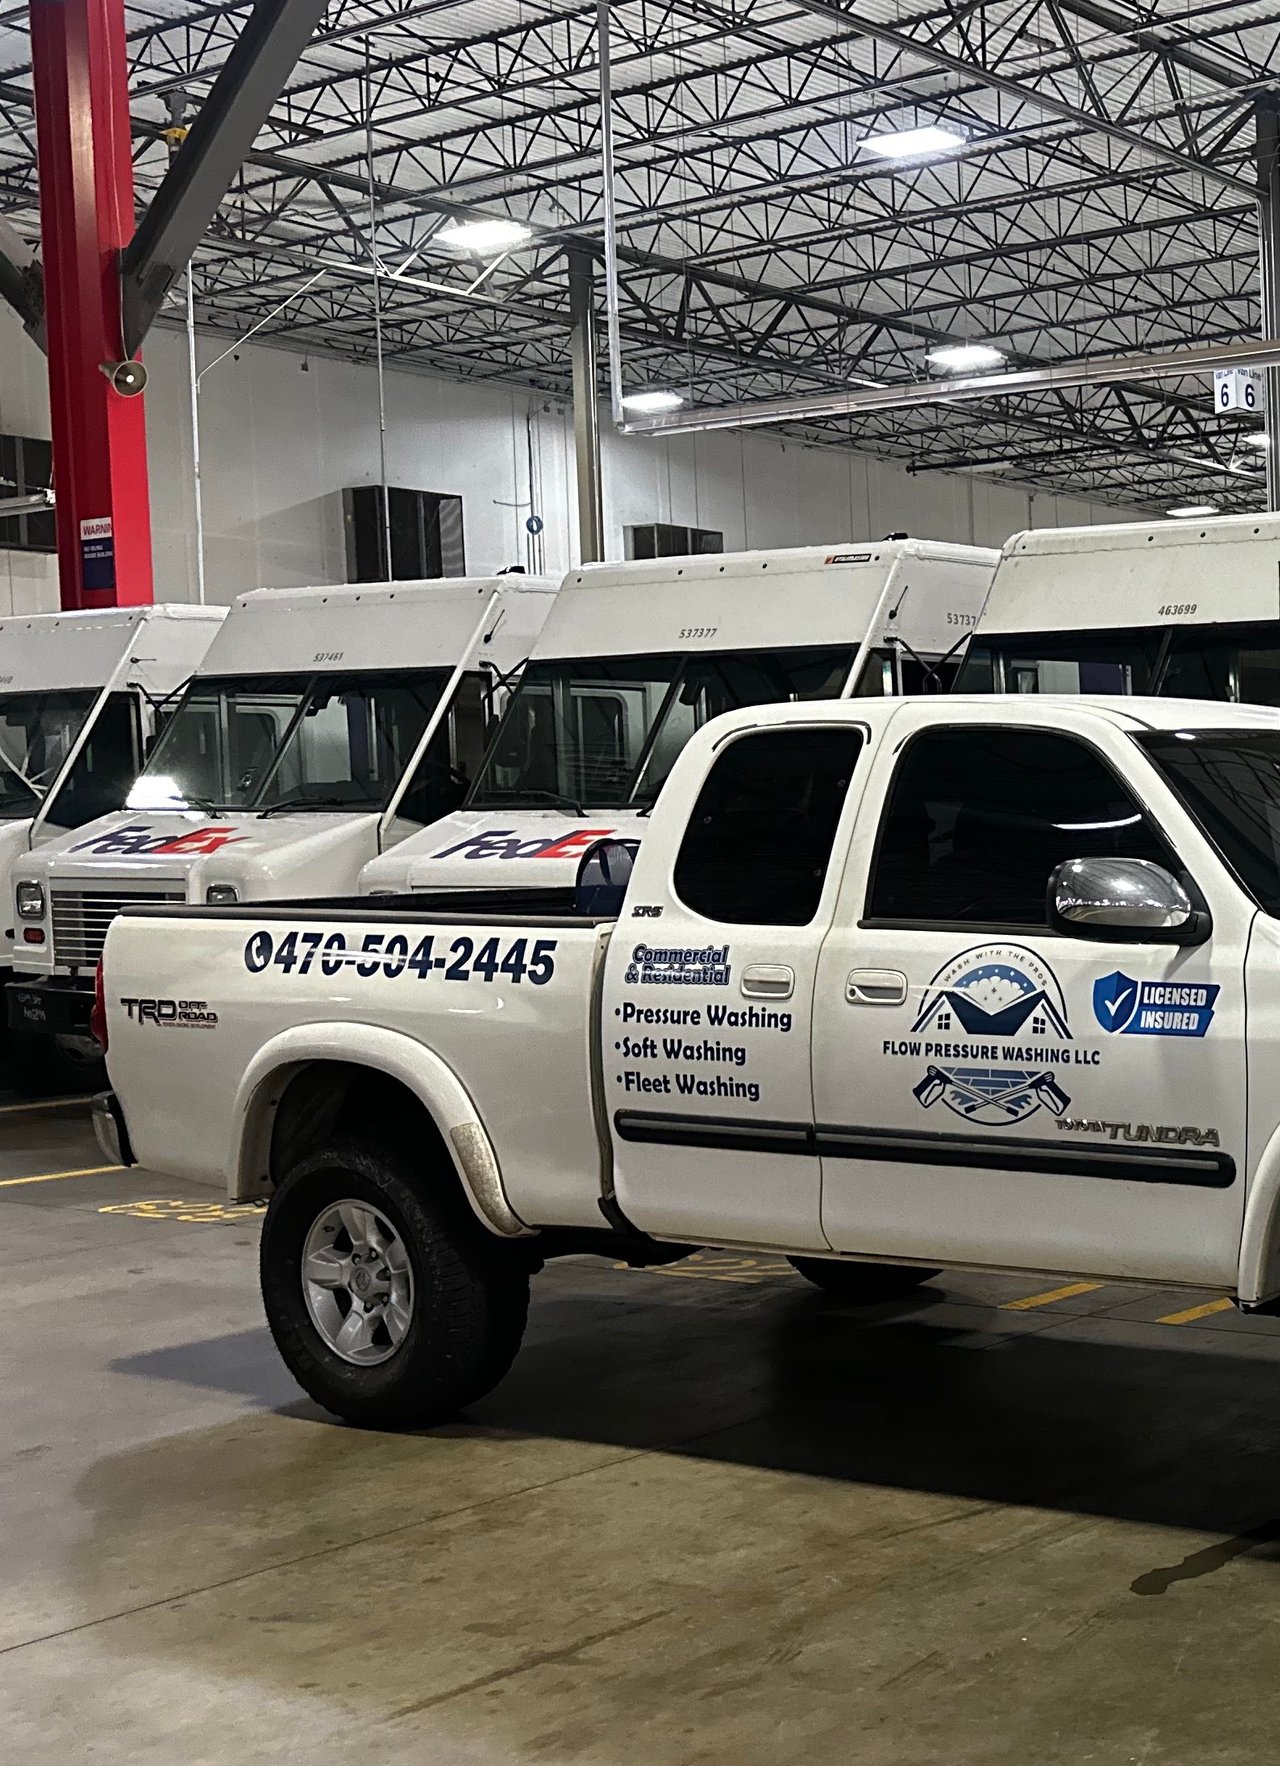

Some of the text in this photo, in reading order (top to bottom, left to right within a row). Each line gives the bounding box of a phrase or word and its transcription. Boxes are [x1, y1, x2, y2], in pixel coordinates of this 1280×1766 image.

[1221, 383, 1229, 407] 6
[1245, 383, 1255, 408] 6
[946, 612, 977, 627] 53737
[1158, 603, 1198, 616] 463699
[678, 627, 718, 639] 537377
[67, 825, 252, 855] FedEx
[429, 829, 618, 860] FedE
[273, 931, 558, 986] 470-504-2445
[632, 943, 730, 965] Commercial
[624, 963, 732, 985] & Residential
[944, 950, 1048, 987] WASH WITH THE PROS
[1143, 986, 1207, 1007] LICENSED
[120, 998, 208, 1027] TRD OFF
[178, 1011, 219, 1024] ROAD
[622, 1002, 792, 1033] Pressure Washing
[1140, 1010, 1200, 1031] INSURED
[622, 1036, 747, 1066] Soft Washing
[883, 1040, 1101, 1065] FLOW PRESSURE WASHING LLC
[623, 1071, 760, 1101] Fleet Washing
[1104, 1122, 1220, 1148] TUNDRA
